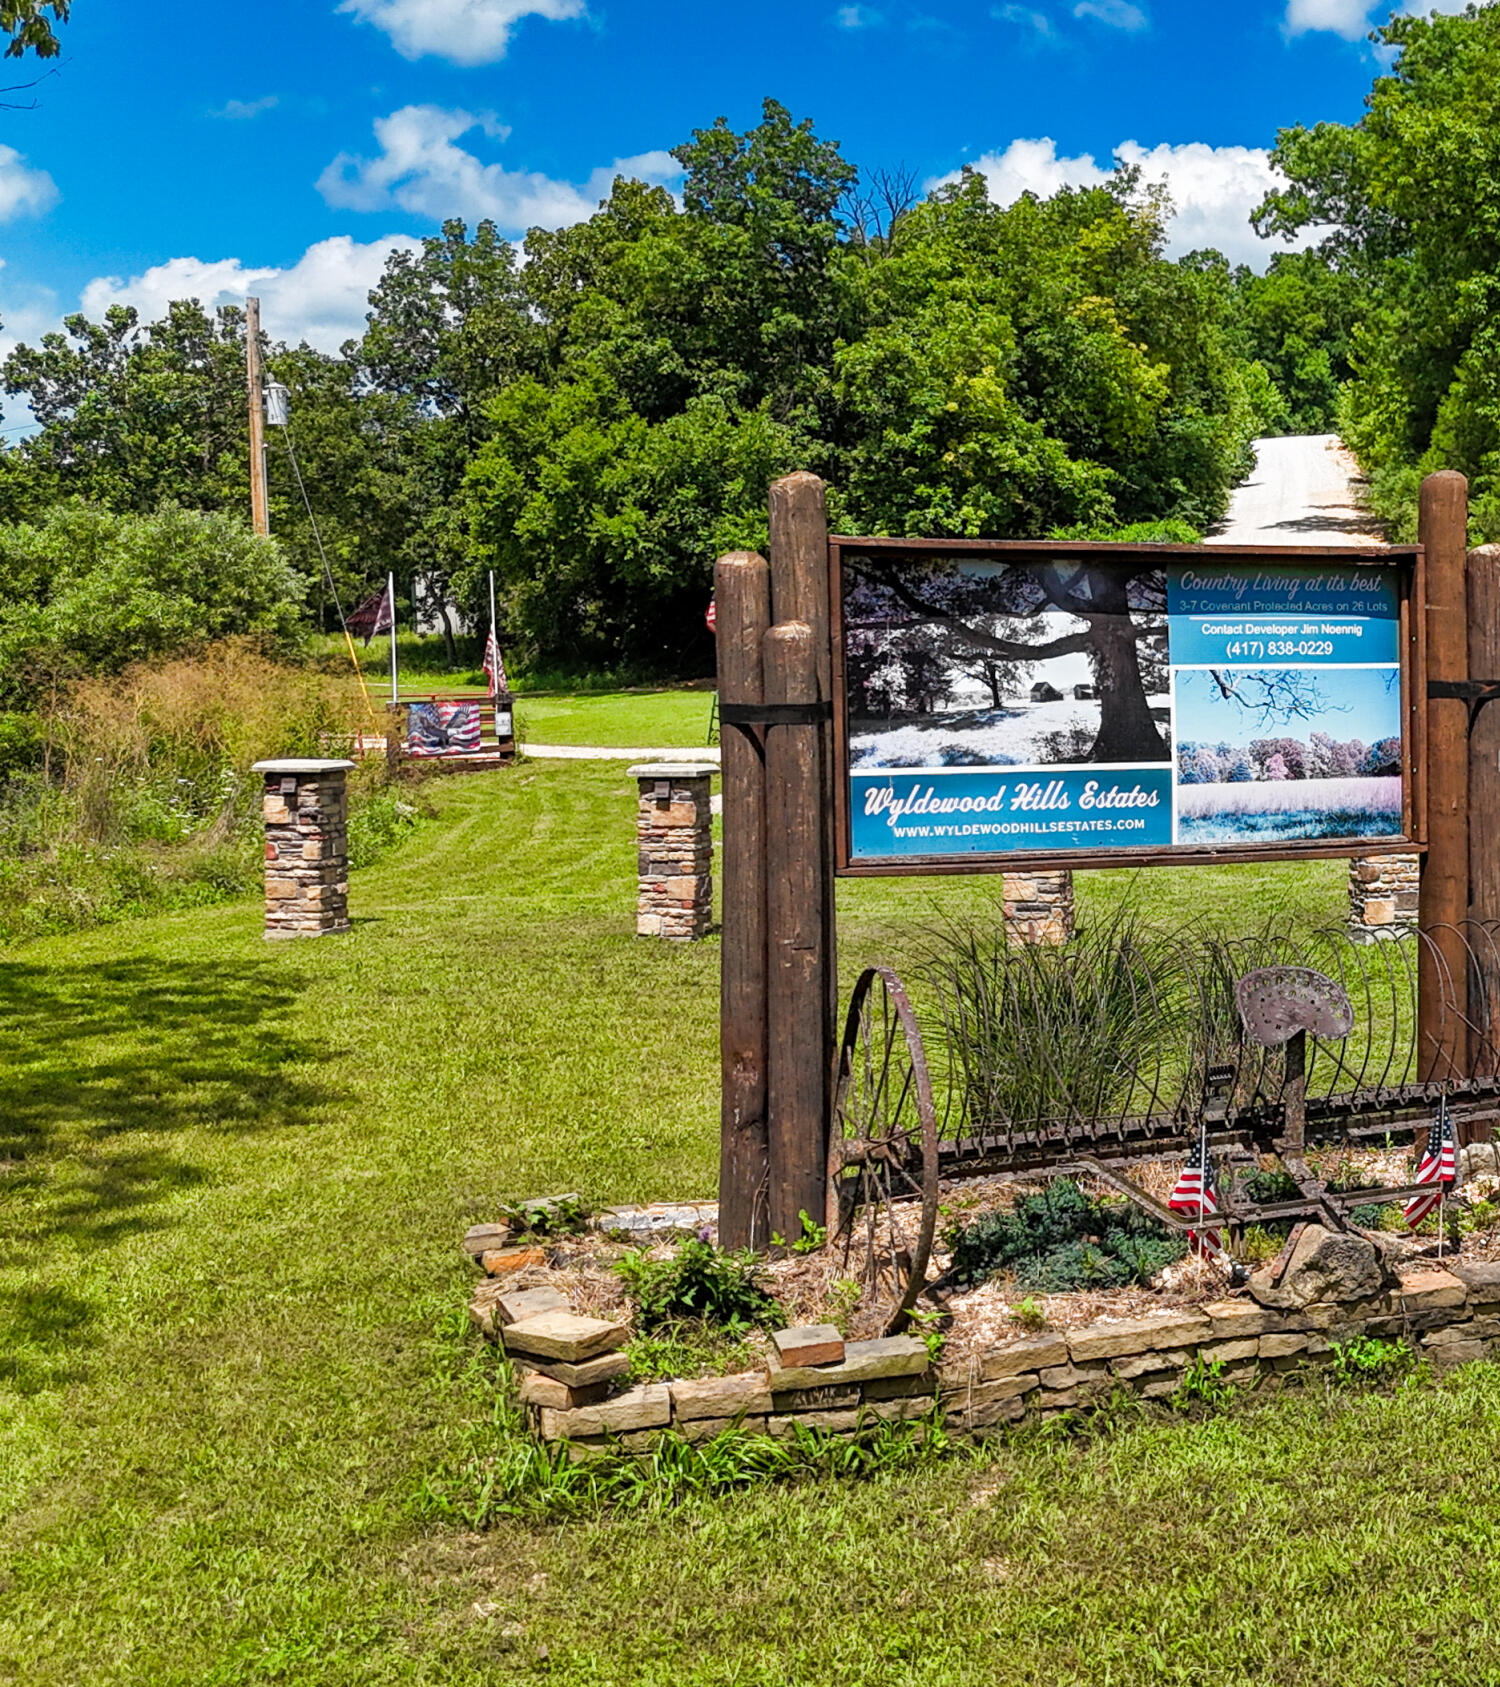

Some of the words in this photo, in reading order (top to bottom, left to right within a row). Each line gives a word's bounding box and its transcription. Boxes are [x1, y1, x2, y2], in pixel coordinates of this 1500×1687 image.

[1180, 570, 1248, 600] Country
[1252, 572, 1301, 600] Living
[1305, 574, 1323, 592] at
[1326, 573, 1345, 592] its
[1349, 572, 1382, 592] best
[1179, 601, 1197, 611] 3-7
[1200, 600, 1251, 611] Covenant
[1253, 600, 1302, 611] Protected
[1305, 601, 1333, 611] Acres
[1336, 603, 1349, 611] on
[1351, 601, 1364, 612] 26
[1366, 602, 1388, 612] Lots
[1202, 623, 1243, 635] Contact
[1245, 623, 1299, 637] Developer
[1301, 623, 1319, 635] Jim
[1321, 623, 1363, 637] Noennig
[1226, 641, 1264, 659] (417)
[1267, 641, 1333, 656] 838-0229
[864, 784, 1007, 827] Wyldewood
[1010, 780, 1071, 812] Hills
[1078, 780, 1160, 811] Estates
[894, 818, 1145, 838] WWW.WYLDEWOODHILLSESTATES.COM
